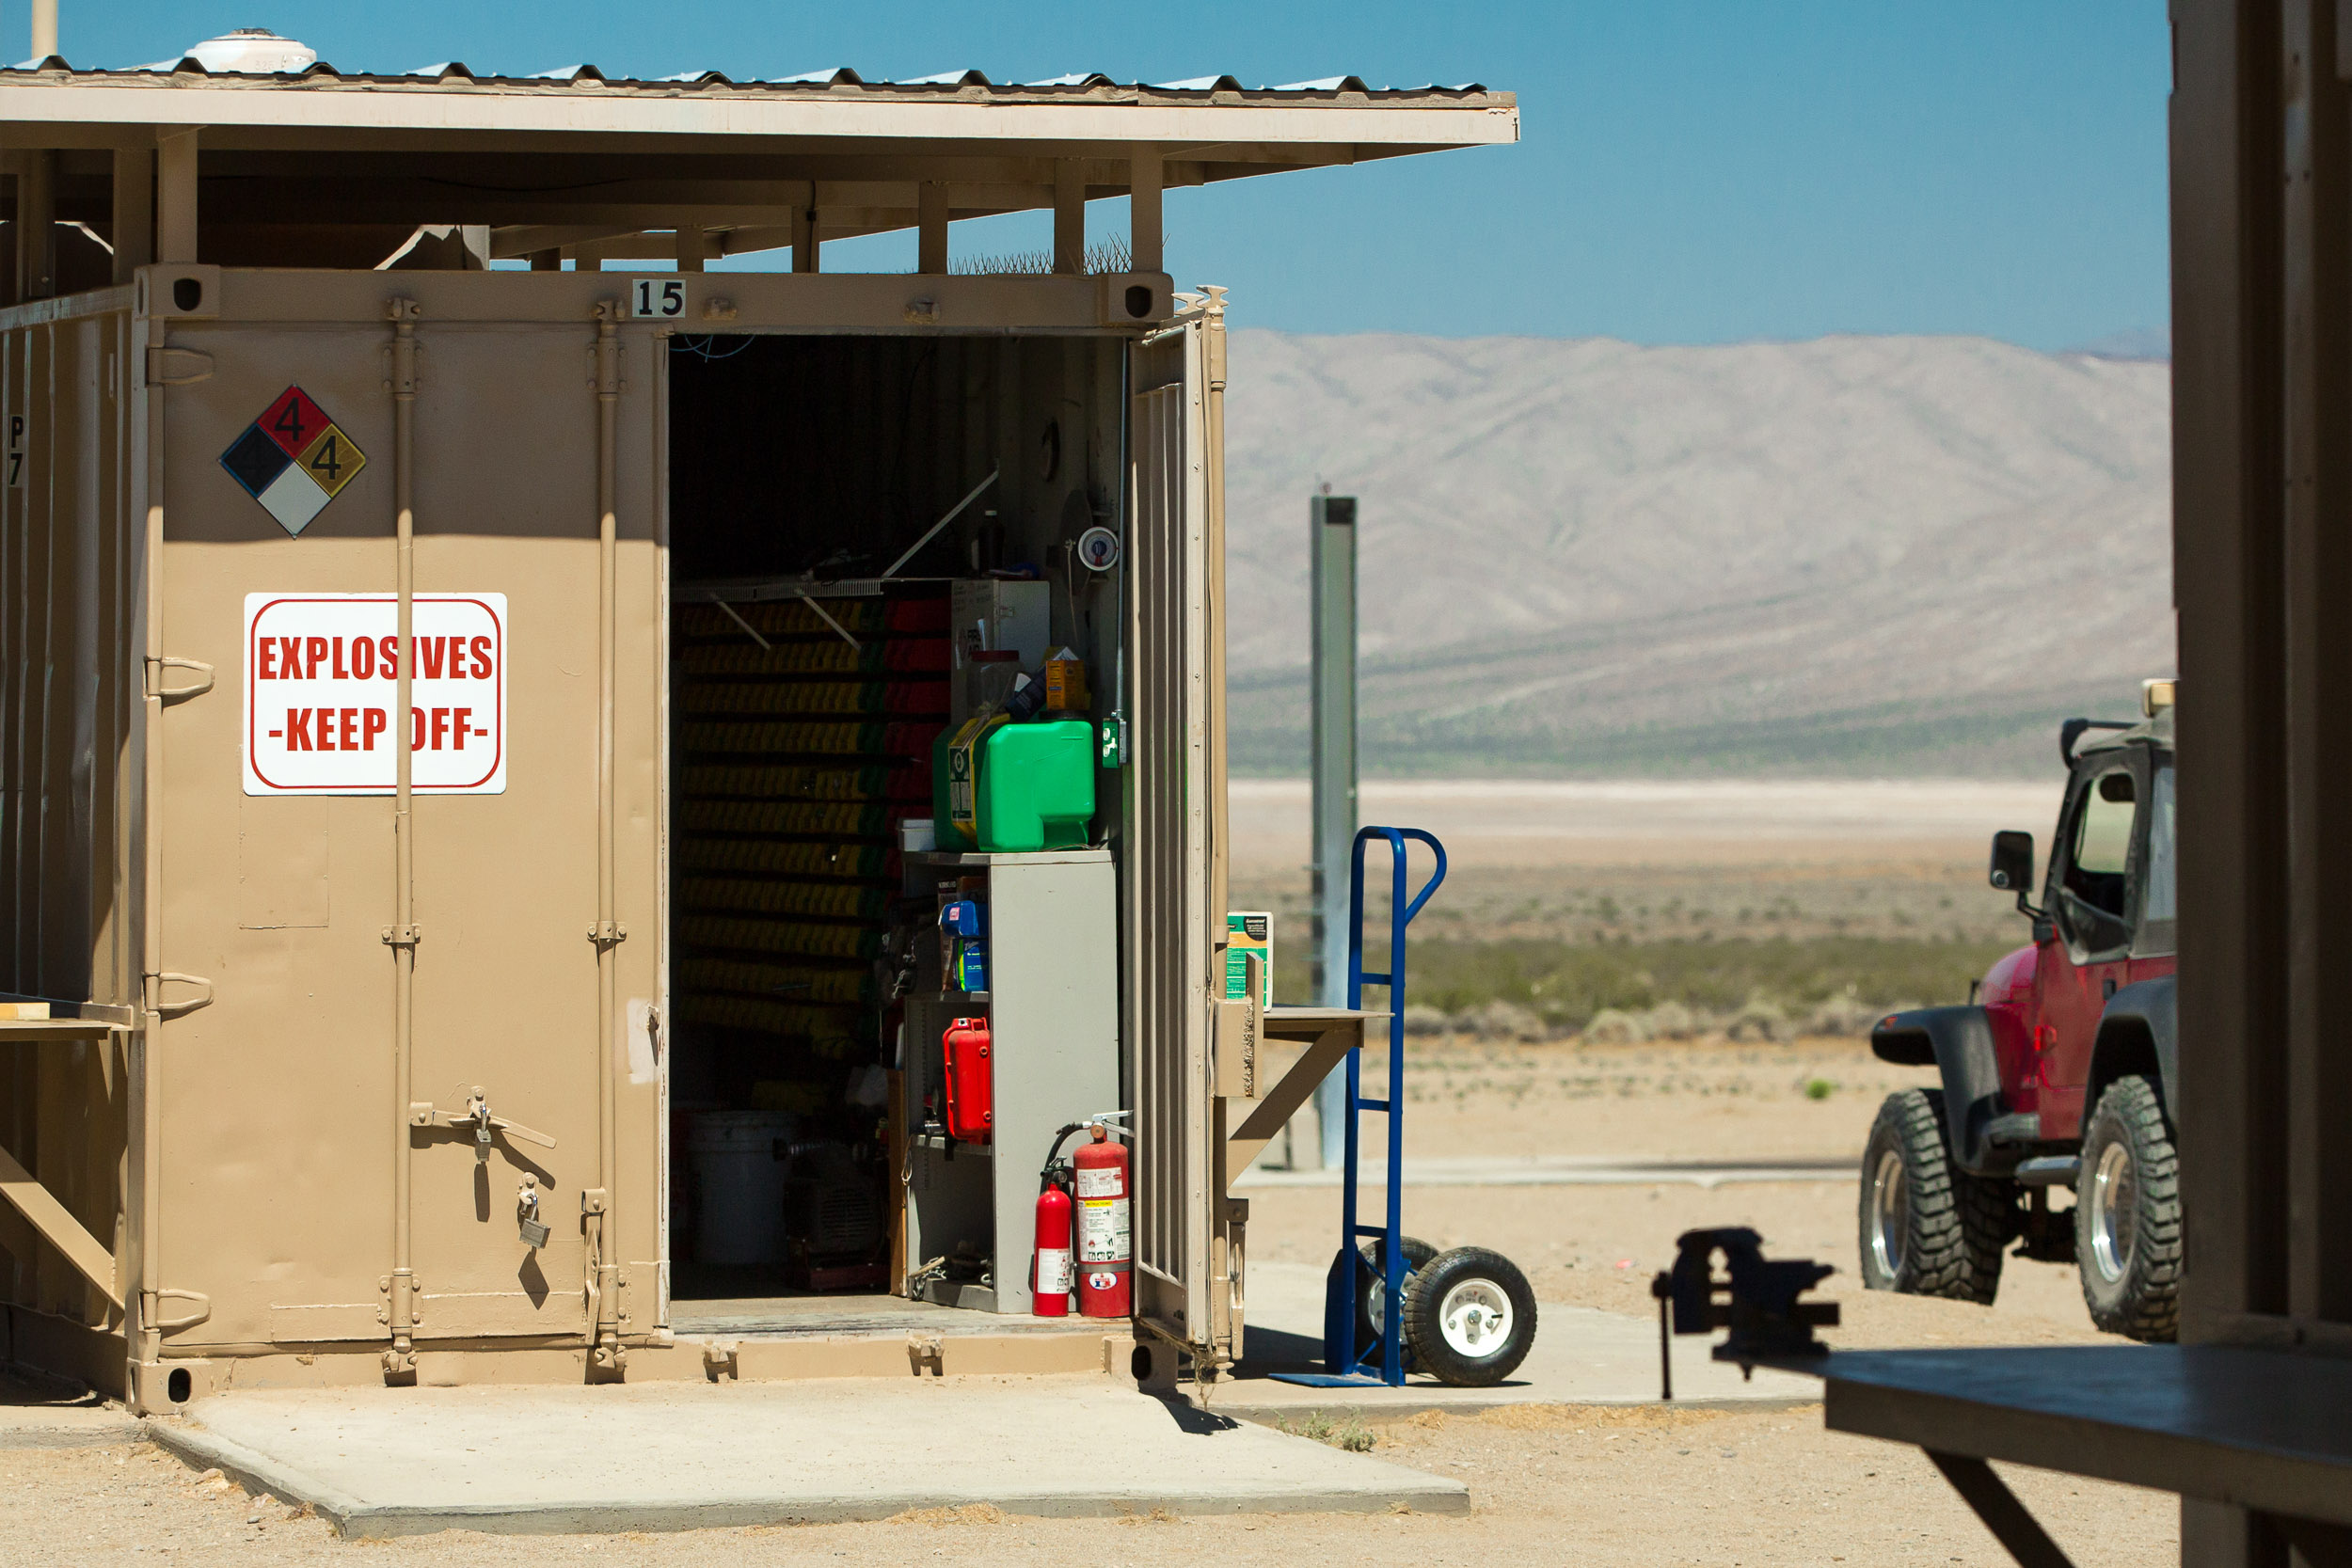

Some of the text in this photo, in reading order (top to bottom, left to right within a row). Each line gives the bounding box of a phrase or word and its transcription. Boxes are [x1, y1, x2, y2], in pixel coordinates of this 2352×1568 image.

[639, 281, 683, 316] 15
[10, 416, 24, 449] P
[274, 397, 306, 441] 4
[9, 452, 24, 485] 7
[311, 435, 342, 480] 4
[269, 707, 387, 752] -KEEP
